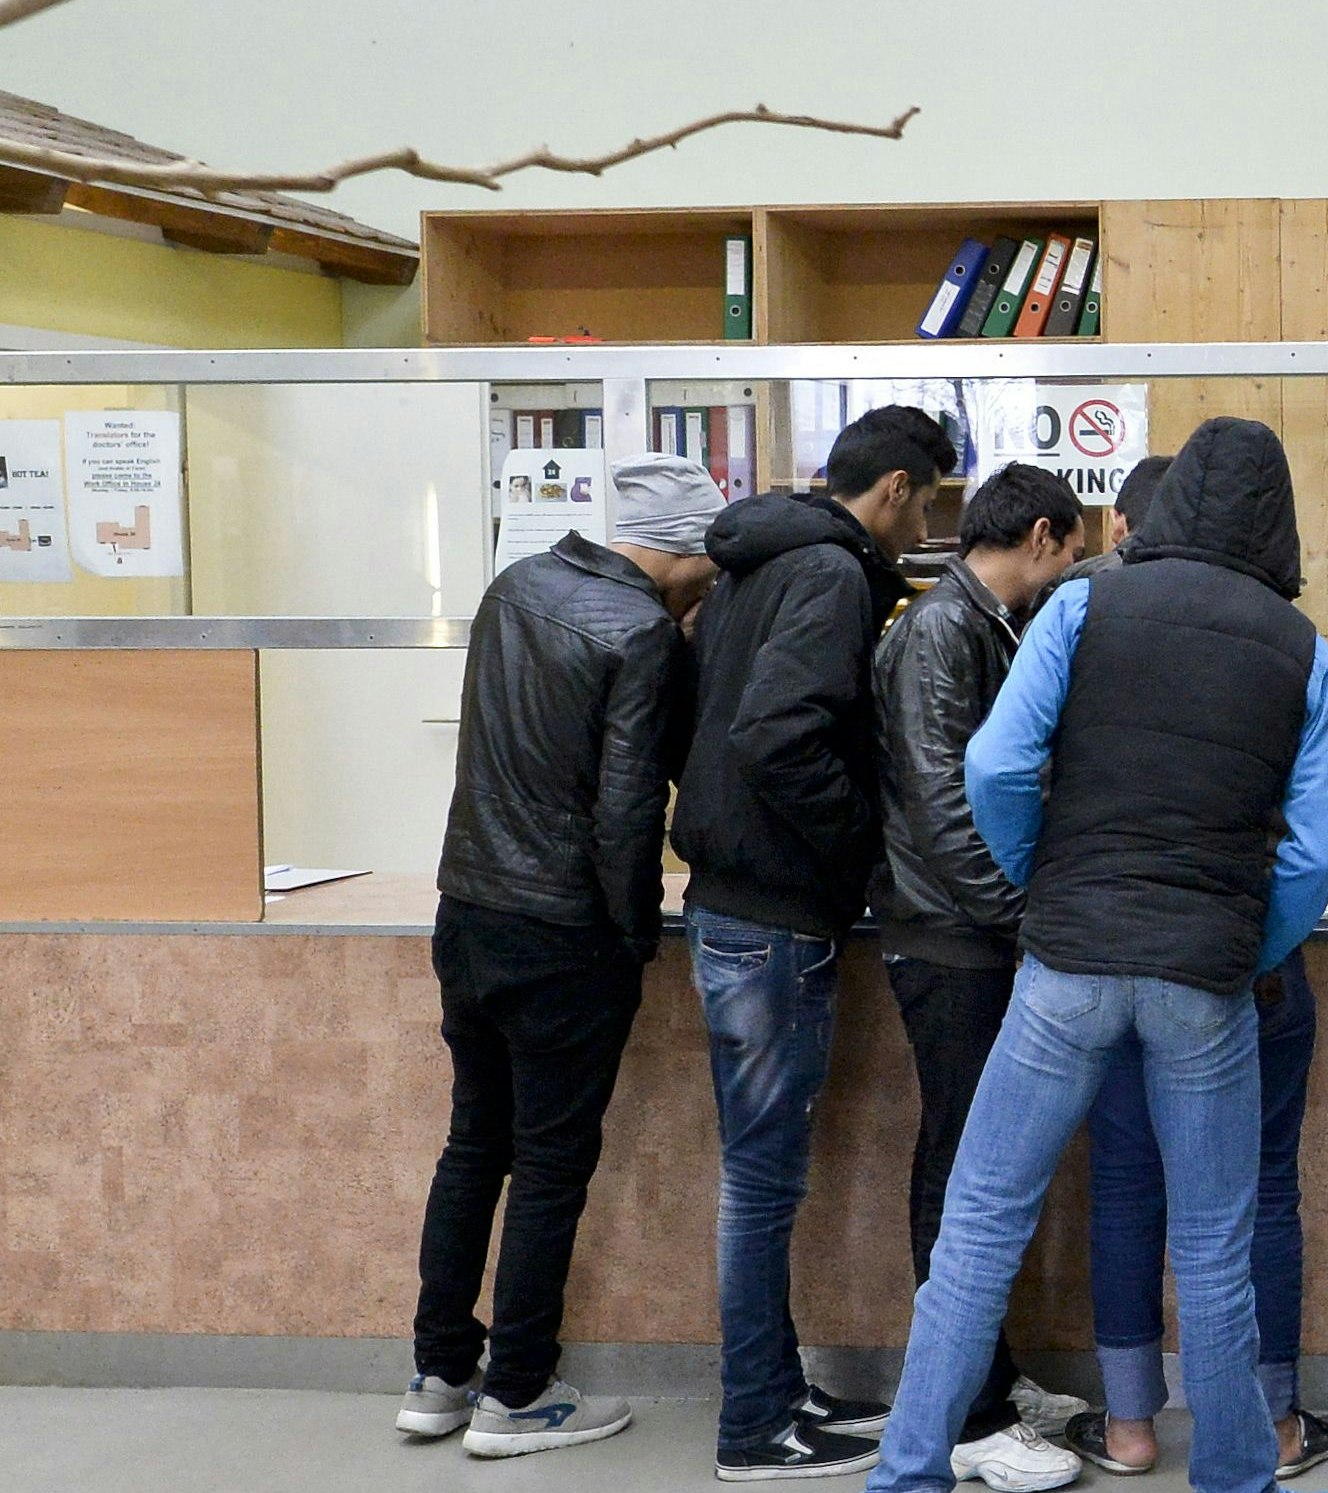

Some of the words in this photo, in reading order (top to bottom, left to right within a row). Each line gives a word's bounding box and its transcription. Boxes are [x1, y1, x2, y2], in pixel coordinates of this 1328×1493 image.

[994, 405, 1061, 449] NO
[12, 470, 27, 478] HOT
[29, 470, 49, 478] TEA!
[1057, 468, 1125, 494] KING
